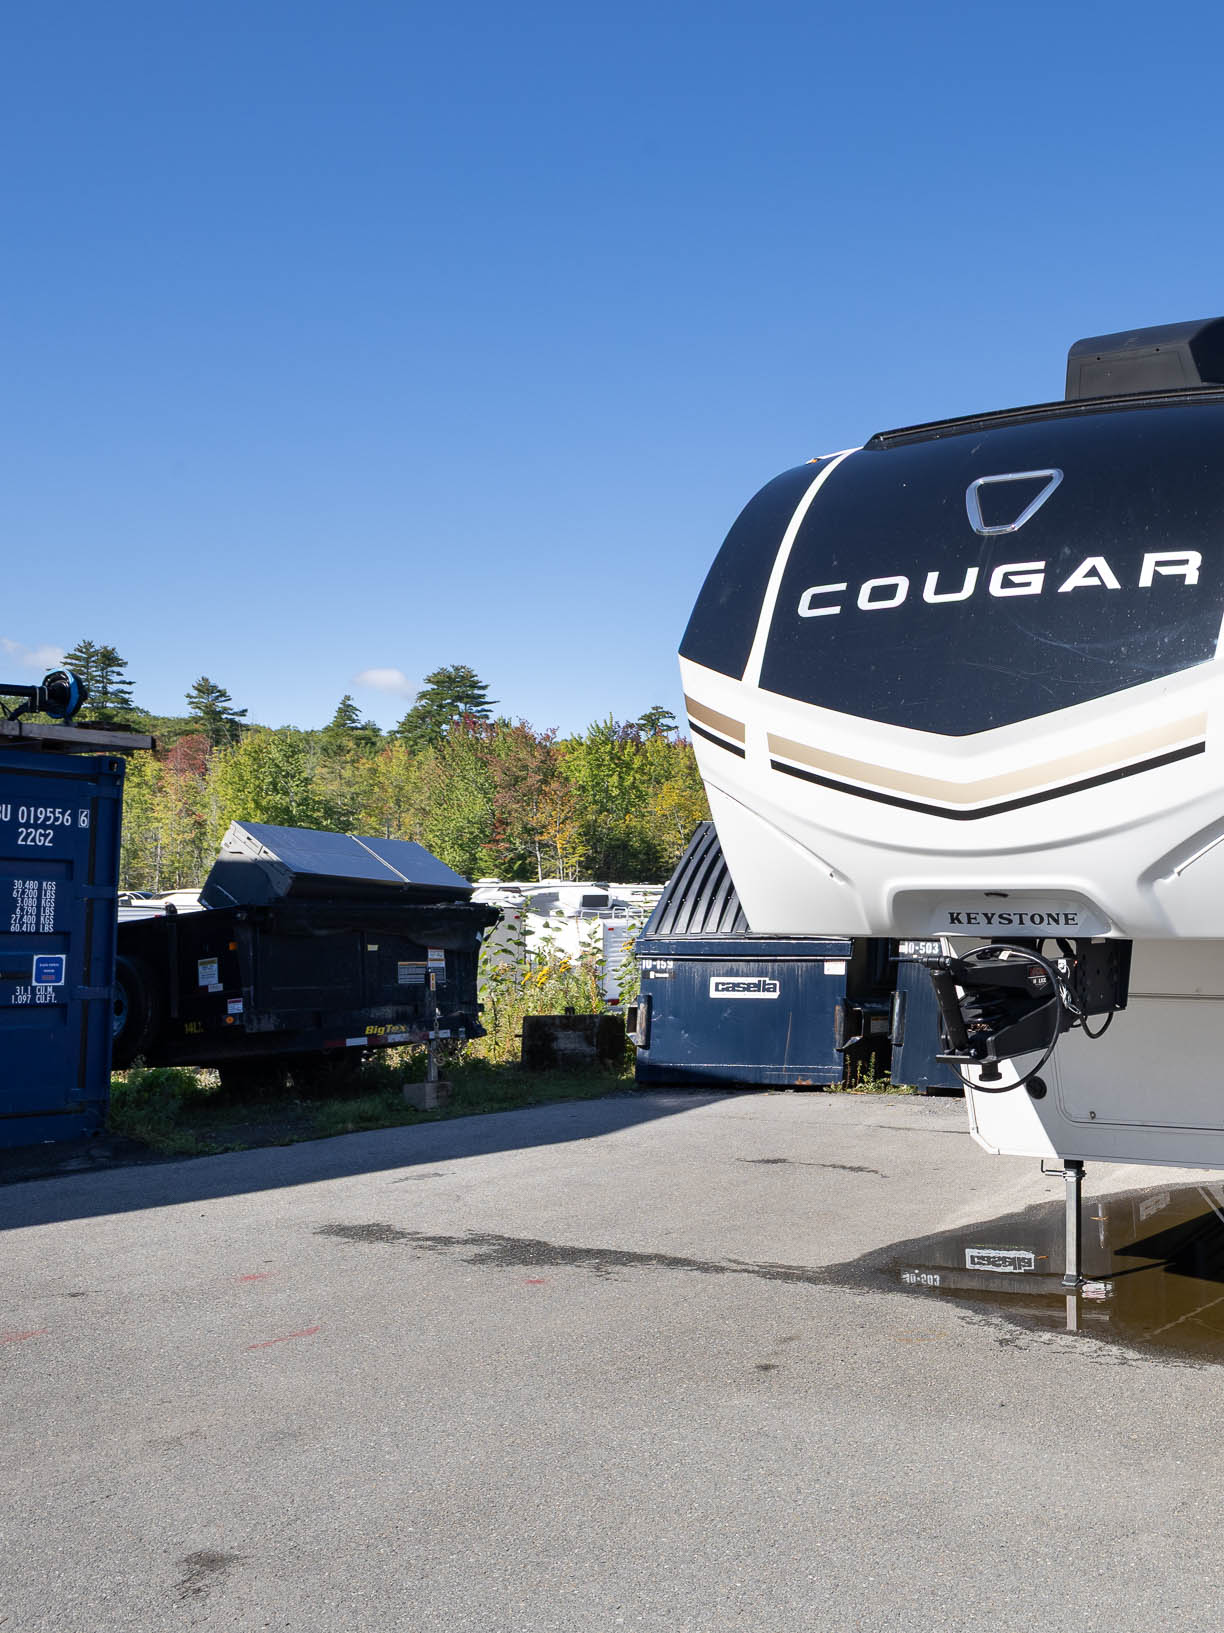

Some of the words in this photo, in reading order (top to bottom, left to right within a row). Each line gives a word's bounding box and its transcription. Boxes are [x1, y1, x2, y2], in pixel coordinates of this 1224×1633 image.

[798, 550, 1203, 618] COUGAR
[0, 804, 11, 821] U
[18, 806, 72, 826] 019556
[79, 810, 89, 827] 6
[17, 827, 54, 846] 22G2
[13, 880, 39, 889] 30.480
[42, 881, 56, 890] KGS
[12, 889, 38, 898] 67.200
[41, 890, 56, 899] LBS
[16, 898, 37, 907] 3.080
[41, 899, 55, 907] KGS
[15, 906, 37, 915] 6.790
[41, 907, 55, 916] LBS
[11, 914, 36, 924] 27.400
[40, 915, 54, 924] KGS
[949, 912, 1079, 926] KEYSTONE
[10, 923, 36, 932] 60.410
[40, 924, 54, 933] LBS
[904, 942, 939, 955] 10-503
[714, 980, 778, 993] casella
[11, 994, 31, 1004] 1.097
